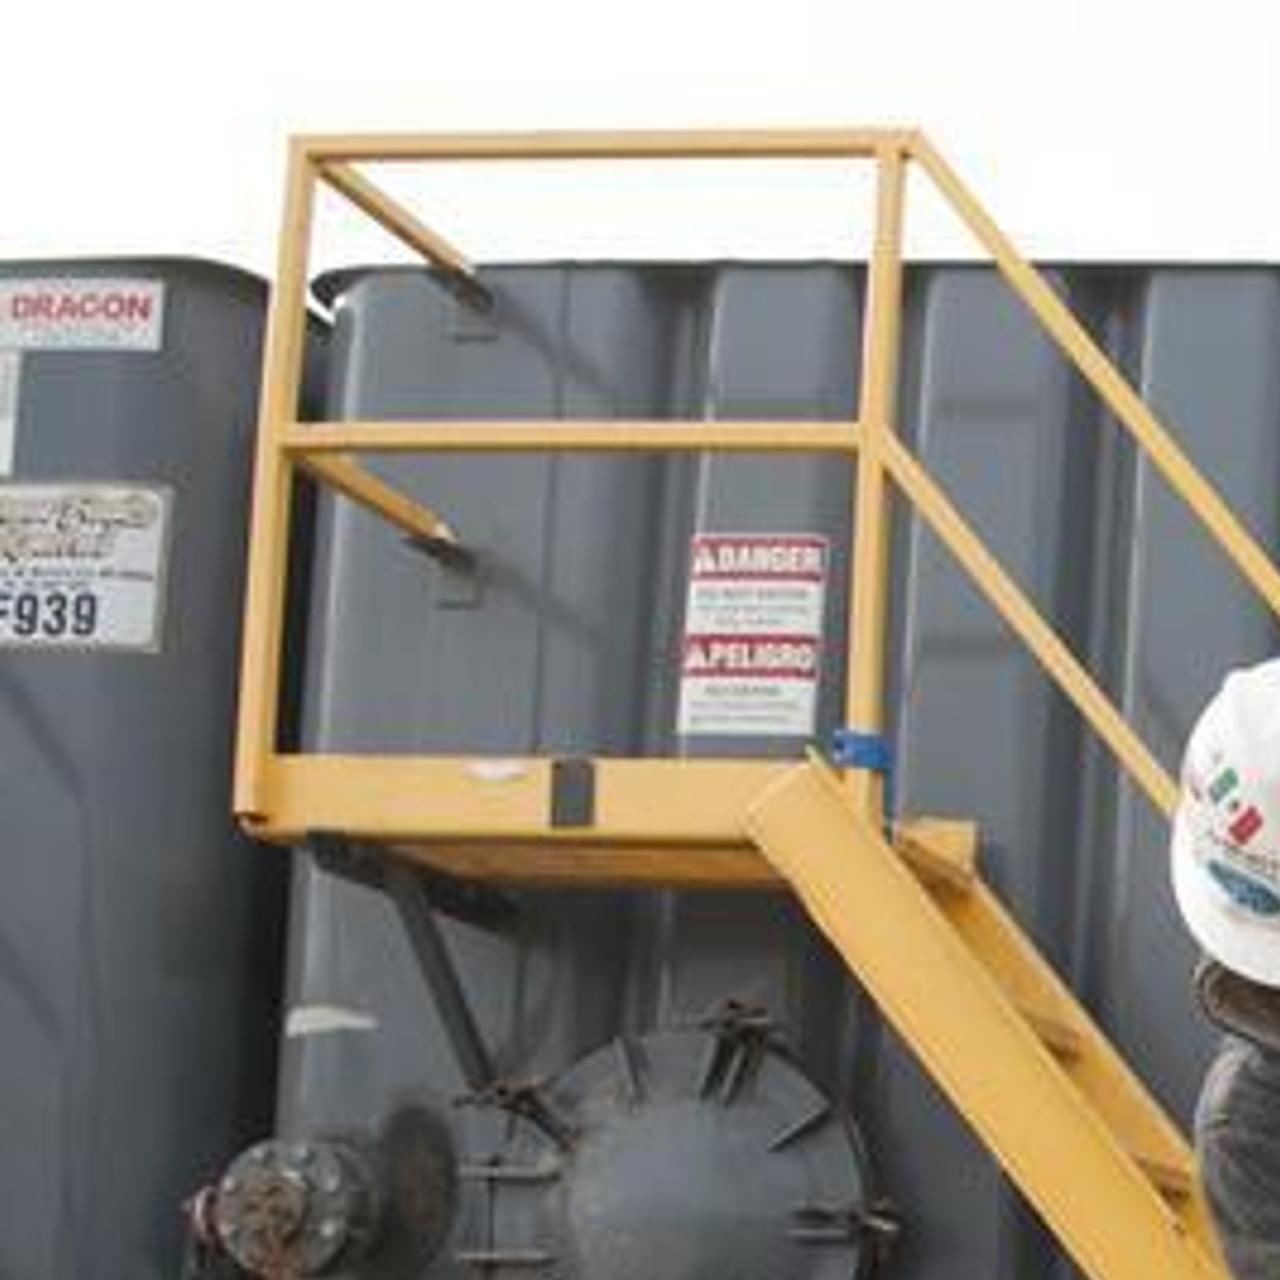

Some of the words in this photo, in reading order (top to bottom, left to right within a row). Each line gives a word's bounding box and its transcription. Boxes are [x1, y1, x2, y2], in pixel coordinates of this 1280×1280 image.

[12, 293, 152, 320] DRAGON
[717, 546, 822, 573] DANGER
[709, 642, 815, 671] PELIGRO
